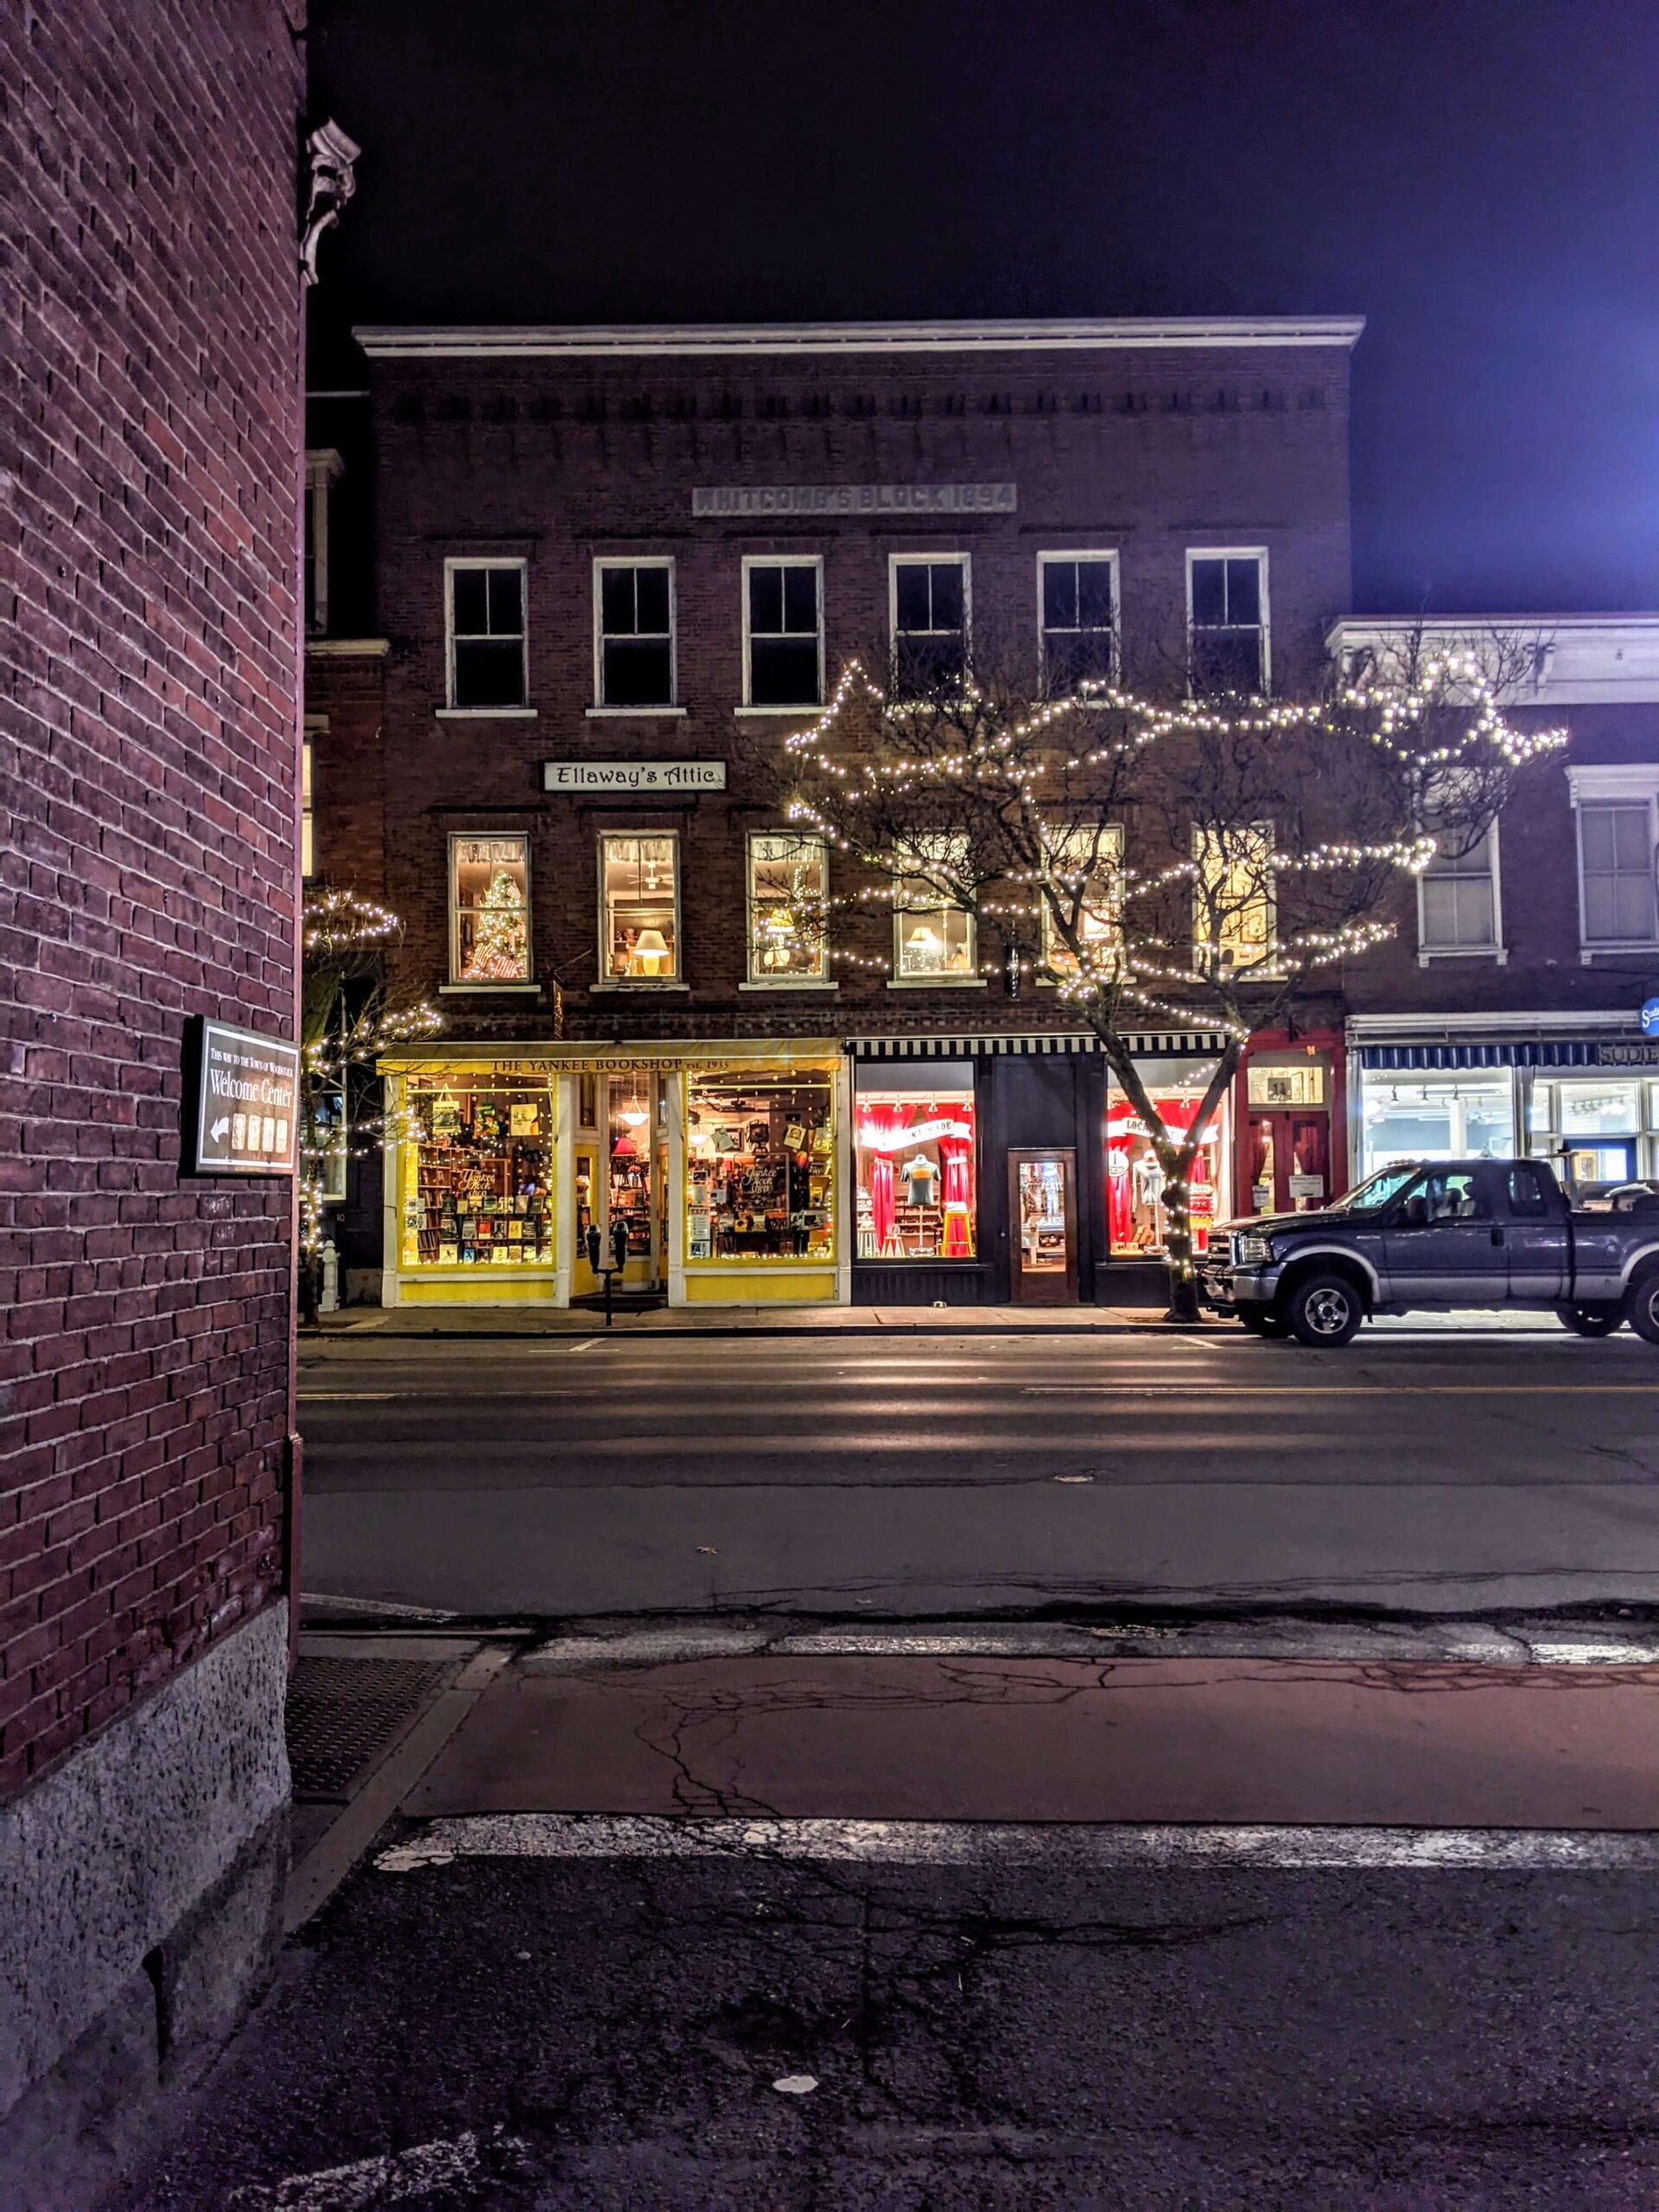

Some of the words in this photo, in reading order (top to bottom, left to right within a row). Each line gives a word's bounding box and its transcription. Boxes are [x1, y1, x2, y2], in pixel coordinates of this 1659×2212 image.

[696, 486, 853, 511] WHITCOMB'S
[859, 486, 944, 509] BLOCK
[953, 484, 1013, 508] 1894
[556, 766, 658, 787] Ellaway's
[664, 766, 715, 785] Attic
[491, 1060, 522, 1071] THE
[528, 1059, 590, 1071] YANKEE
[595, 1058, 683, 1070] BOOKSHOP
[210, 1068, 257, 1102] Welcome
[261, 1078, 293, 1107] Center
[337, 1213, 346, 1223] 10
